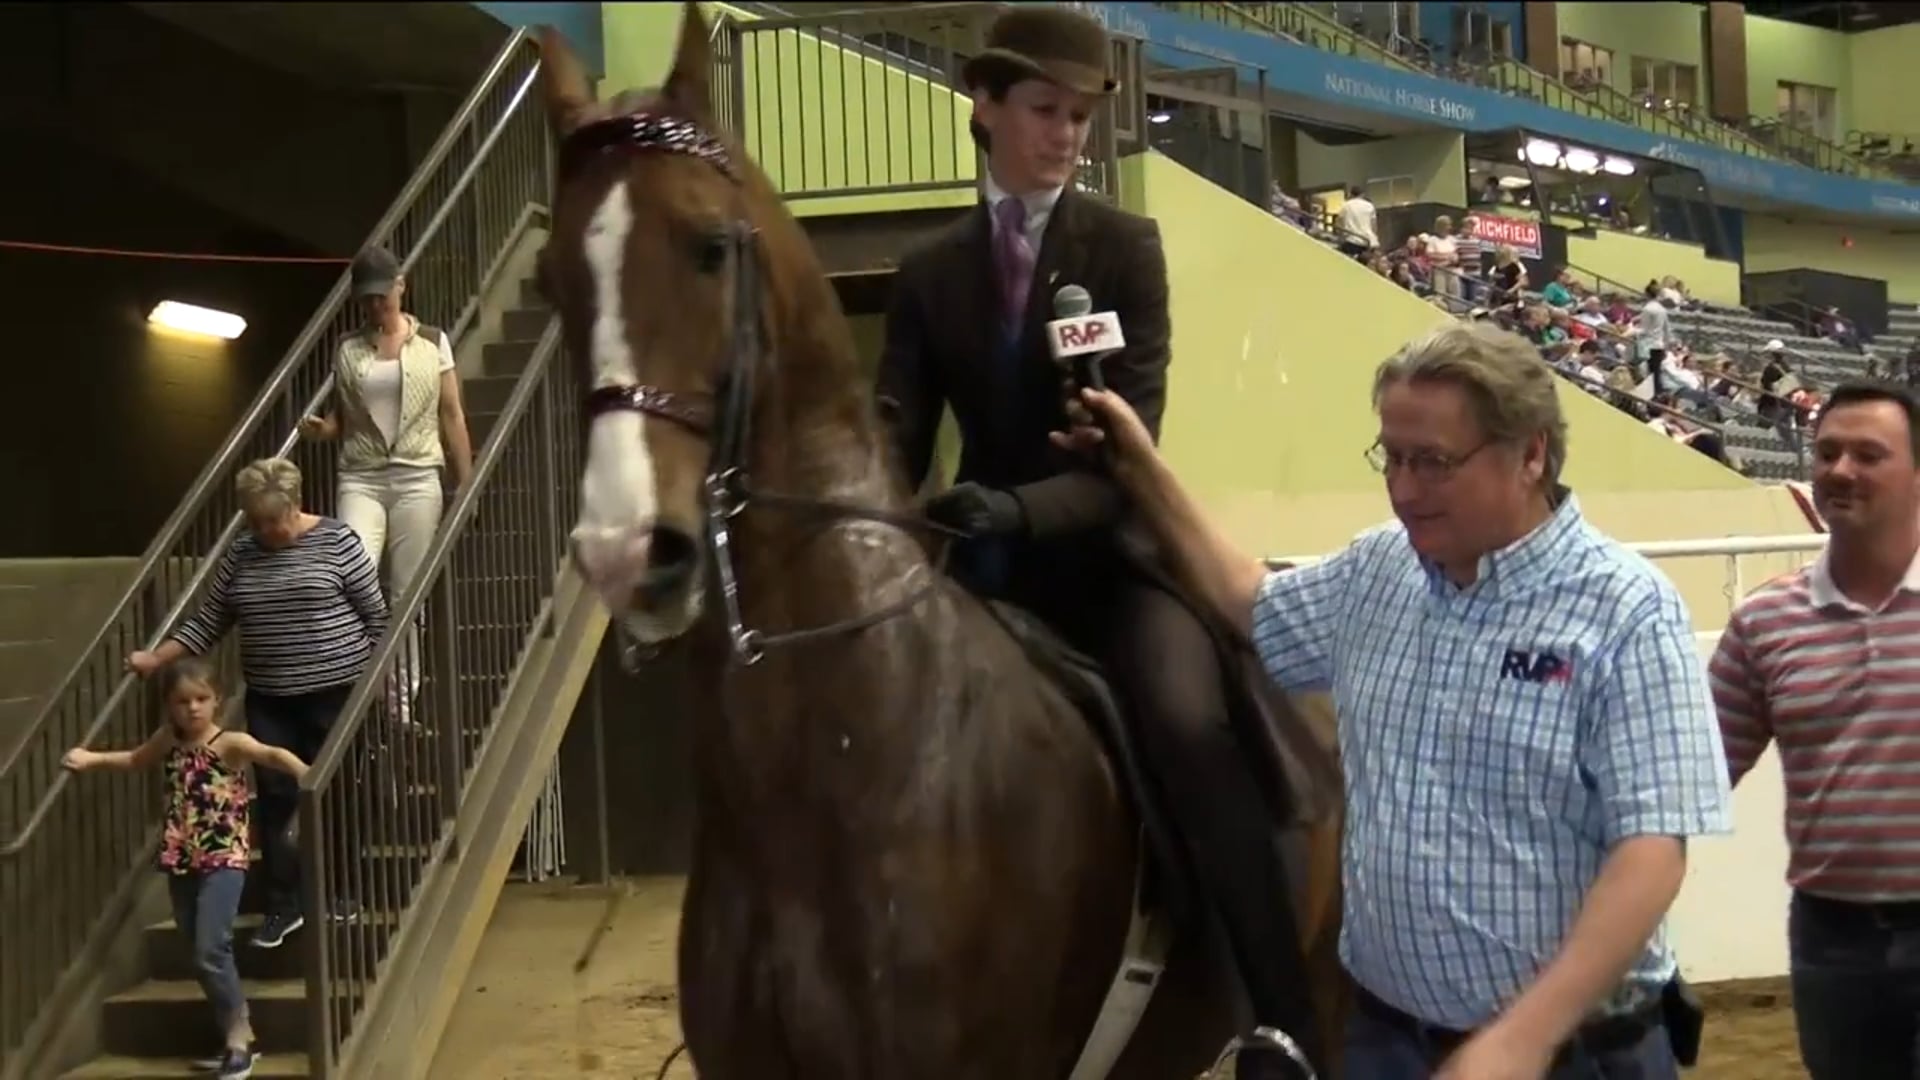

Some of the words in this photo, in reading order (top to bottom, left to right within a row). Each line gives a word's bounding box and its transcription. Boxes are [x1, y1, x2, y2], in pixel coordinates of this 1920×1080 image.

[1325, 73, 1391, 104] NATIONAL
[1396, 88, 1436, 114] HORSE
[1439, 97, 1476, 121] SHOW
[1473, 218, 1537, 243] RICHFIELD
[1059, 321, 1106, 347] RVP
